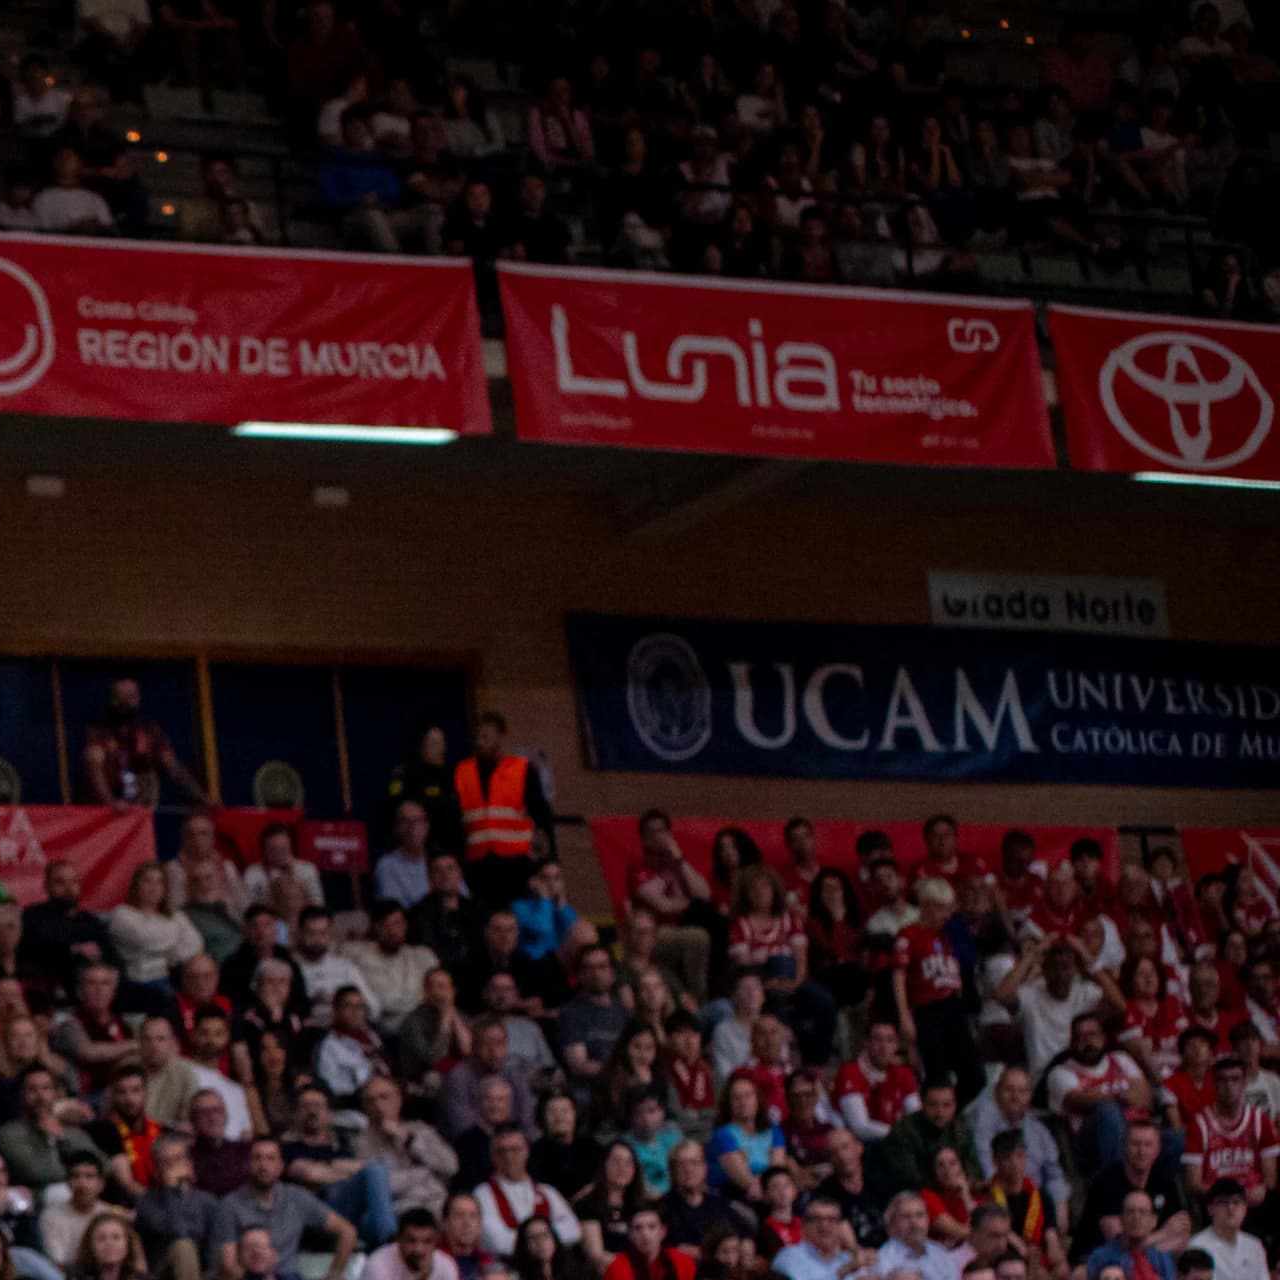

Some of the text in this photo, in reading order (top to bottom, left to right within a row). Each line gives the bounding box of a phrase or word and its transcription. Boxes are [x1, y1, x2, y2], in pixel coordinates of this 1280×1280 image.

[77, 326, 447, 381] REGIÓN DE MURCIA
[729, 663, 1040, 754] UCAM
[1051, 720, 1183, 757] CATÓLICA
[1192, 731, 1226, 758] DE
